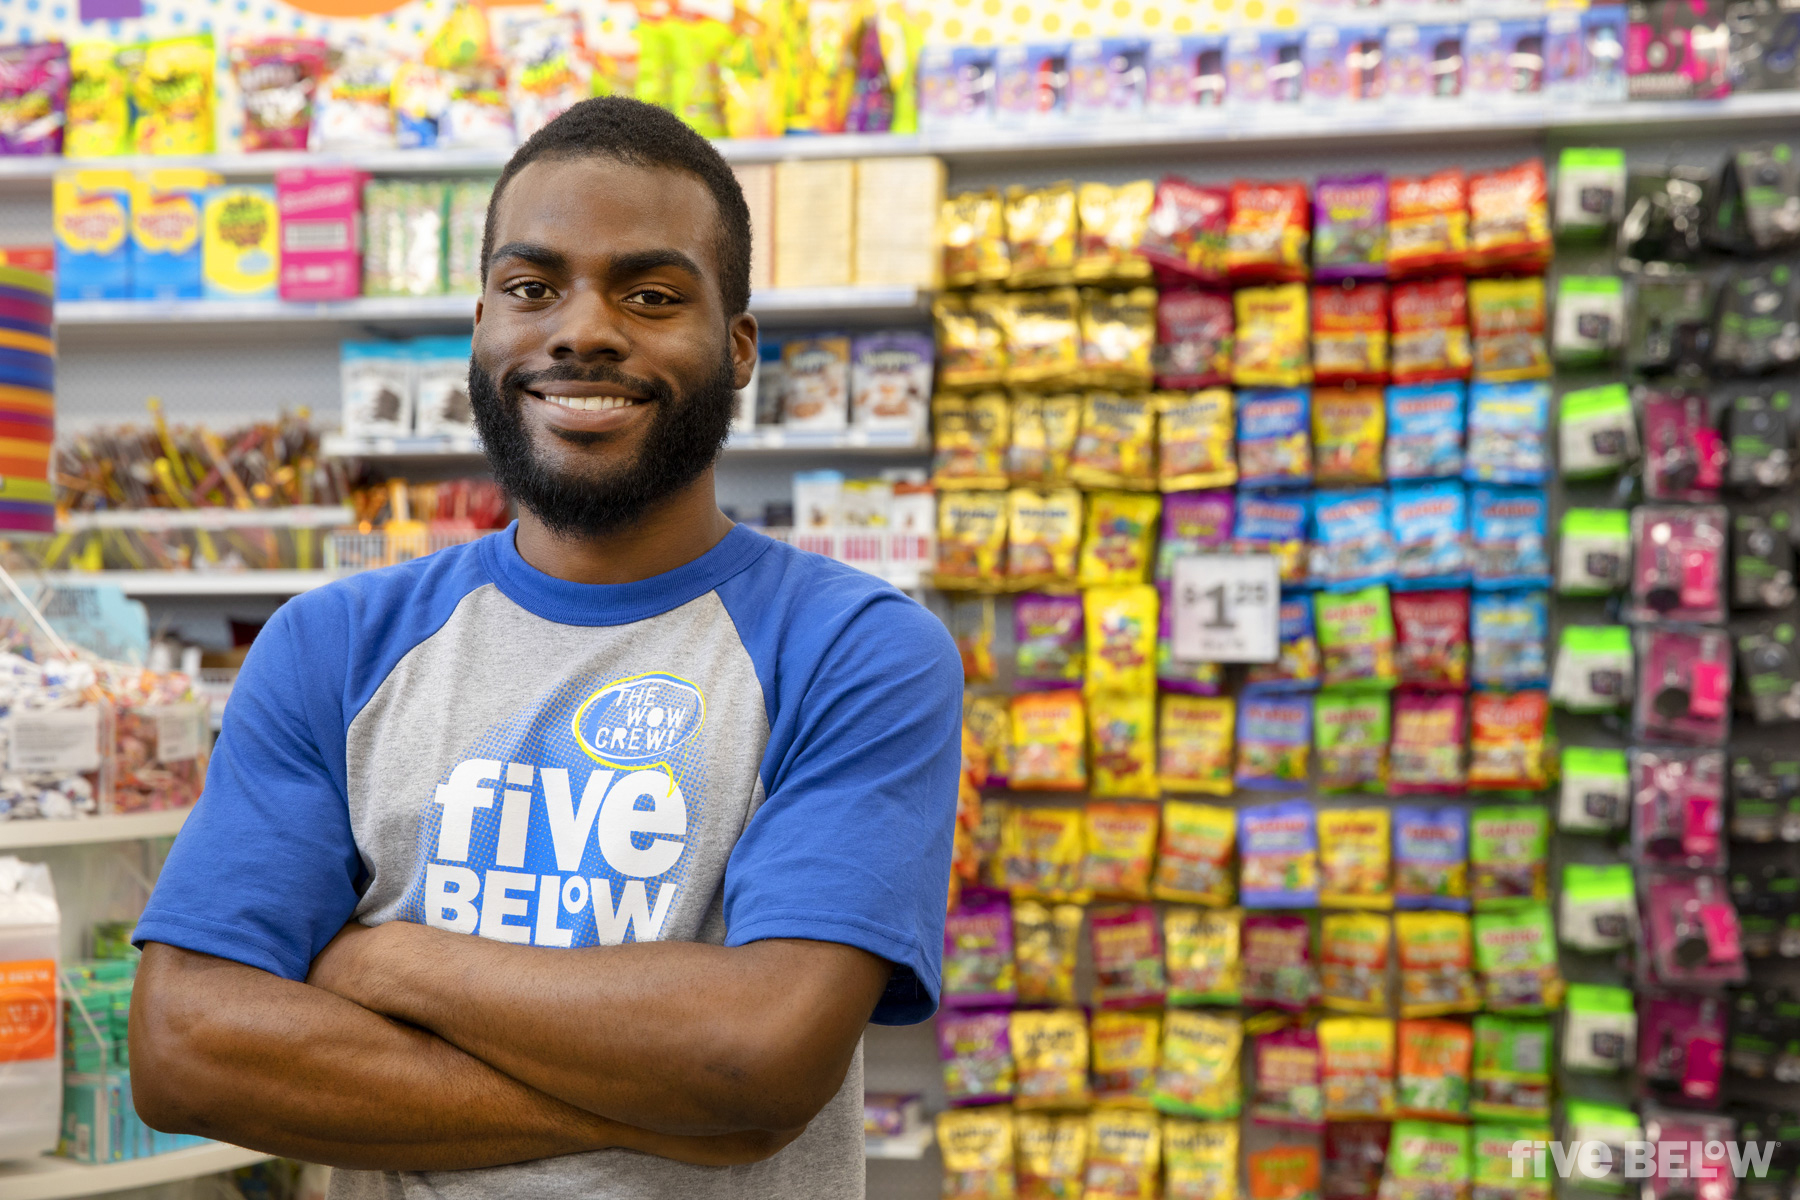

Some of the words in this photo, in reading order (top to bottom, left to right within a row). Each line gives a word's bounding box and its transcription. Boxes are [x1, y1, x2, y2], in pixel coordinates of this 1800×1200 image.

[615, 686, 660, 707] THE
[627, 706, 686, 728] WOW
[594, 726, 675, 751] CREW!
[434, 758, 687, 878] five
[425, 862, 677, 948] BELOW
